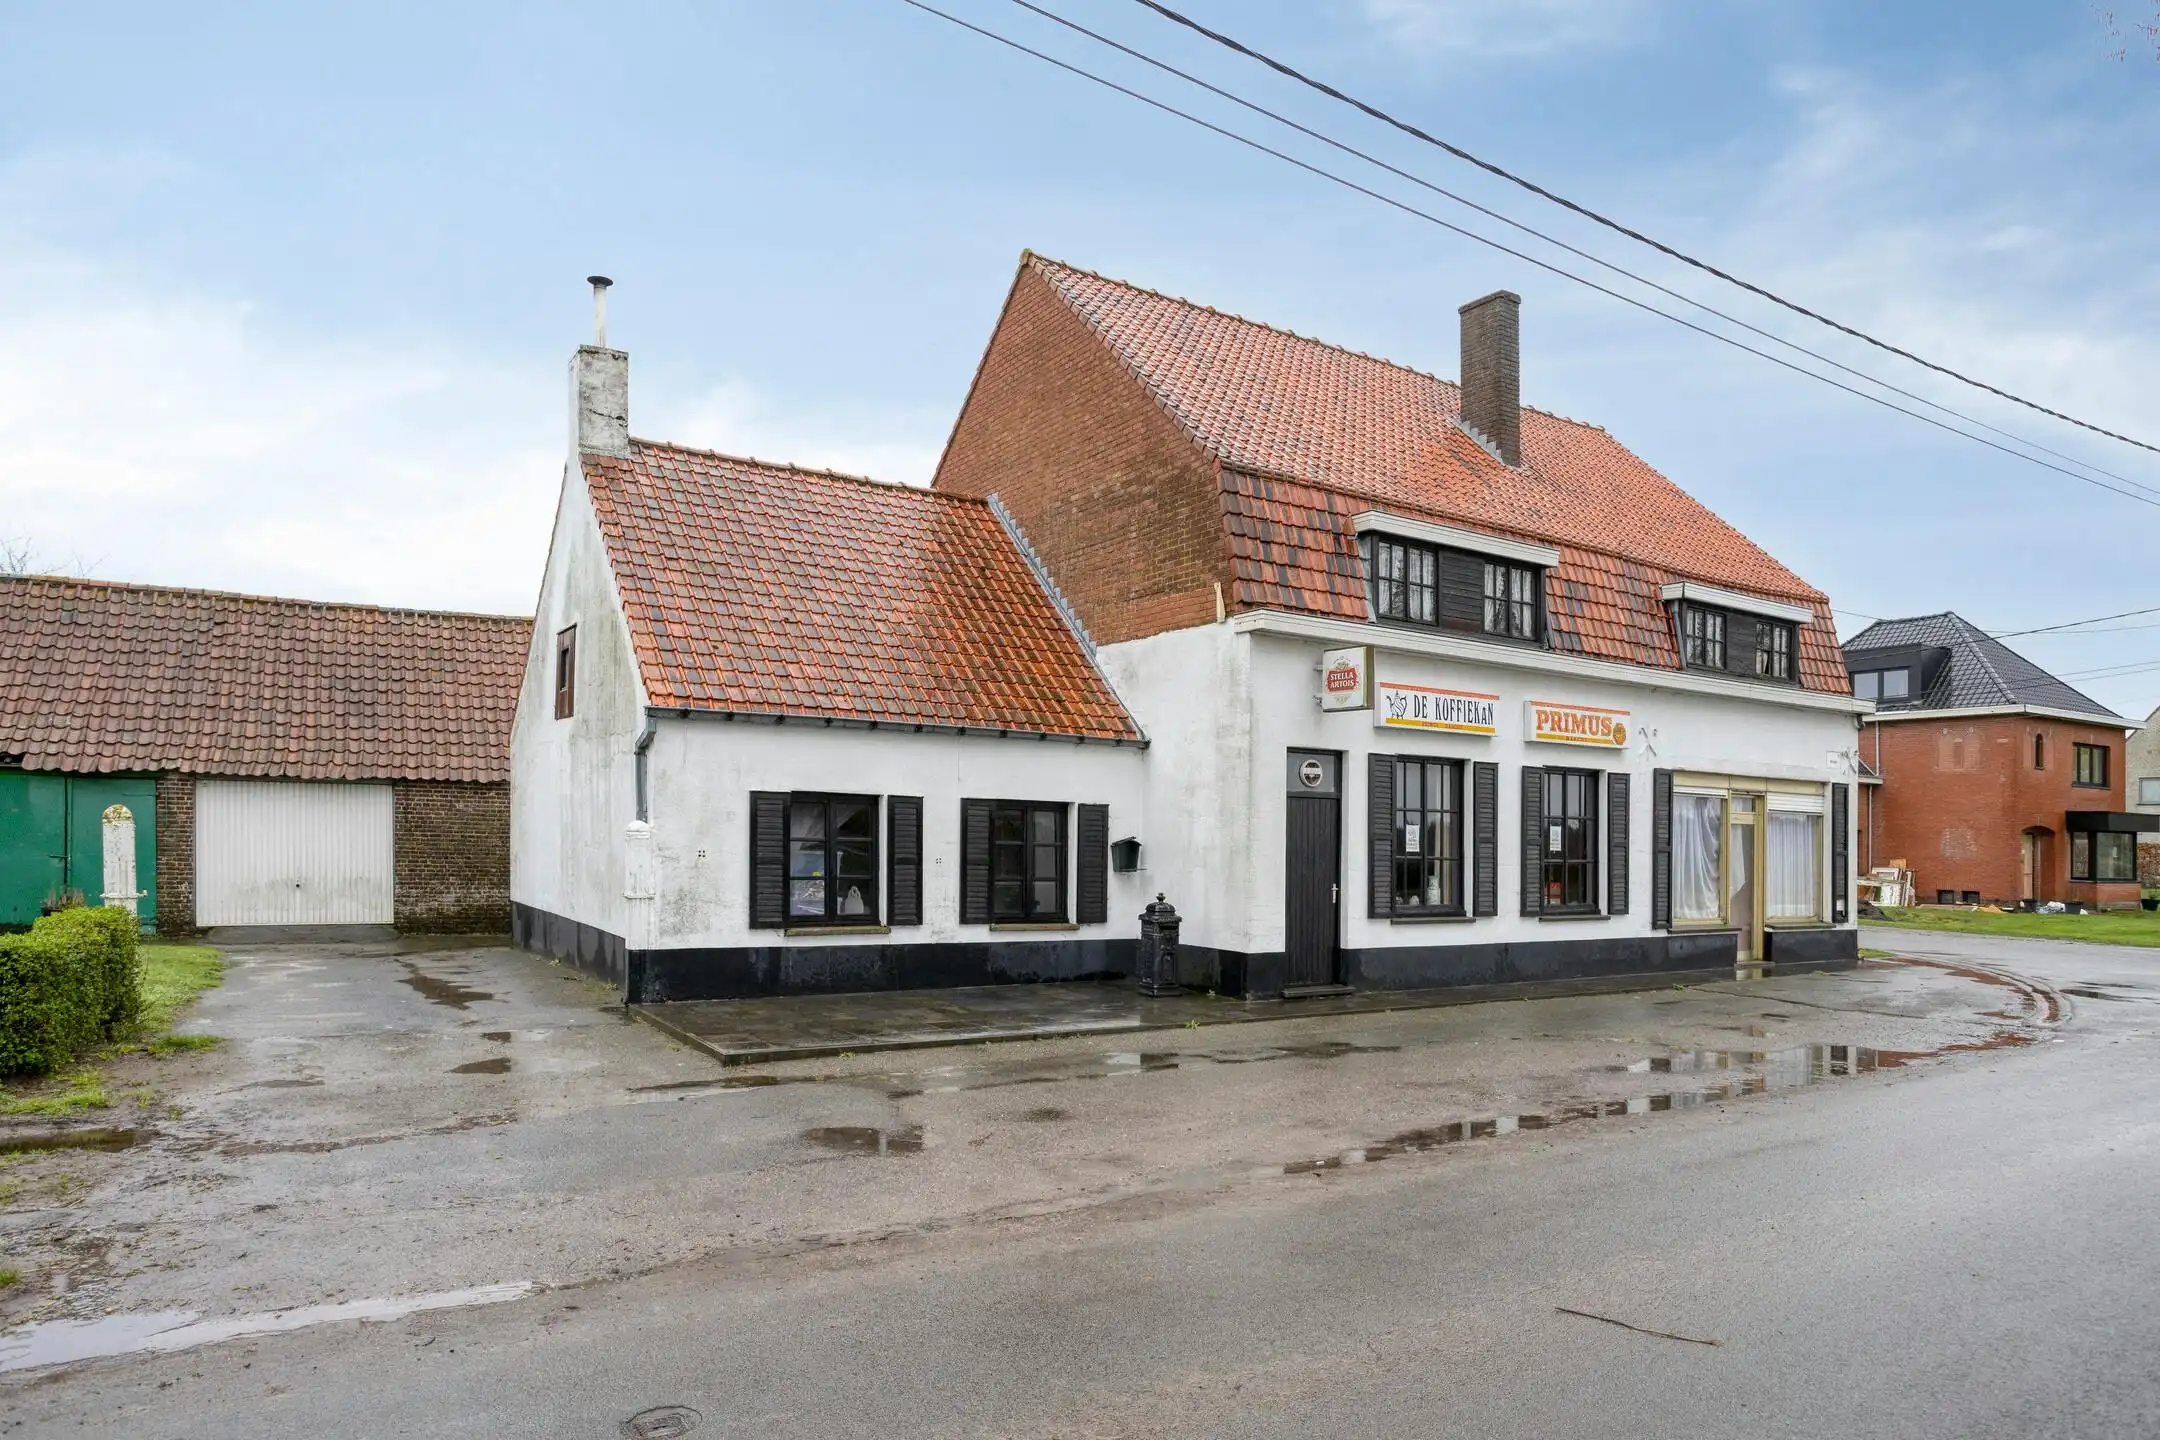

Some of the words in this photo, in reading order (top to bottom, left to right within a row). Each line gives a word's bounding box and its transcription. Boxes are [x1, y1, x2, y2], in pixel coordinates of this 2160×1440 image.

[1330, 671, 1354, 680] STELLA
[1330, 680, 1354, 689] ARTOIS
[1414, 694, 1428, 718] DE
[1435, 697, 1494, 725] KOFFIEKAN
[1536, 709, 1612, 736] PRIMUS
